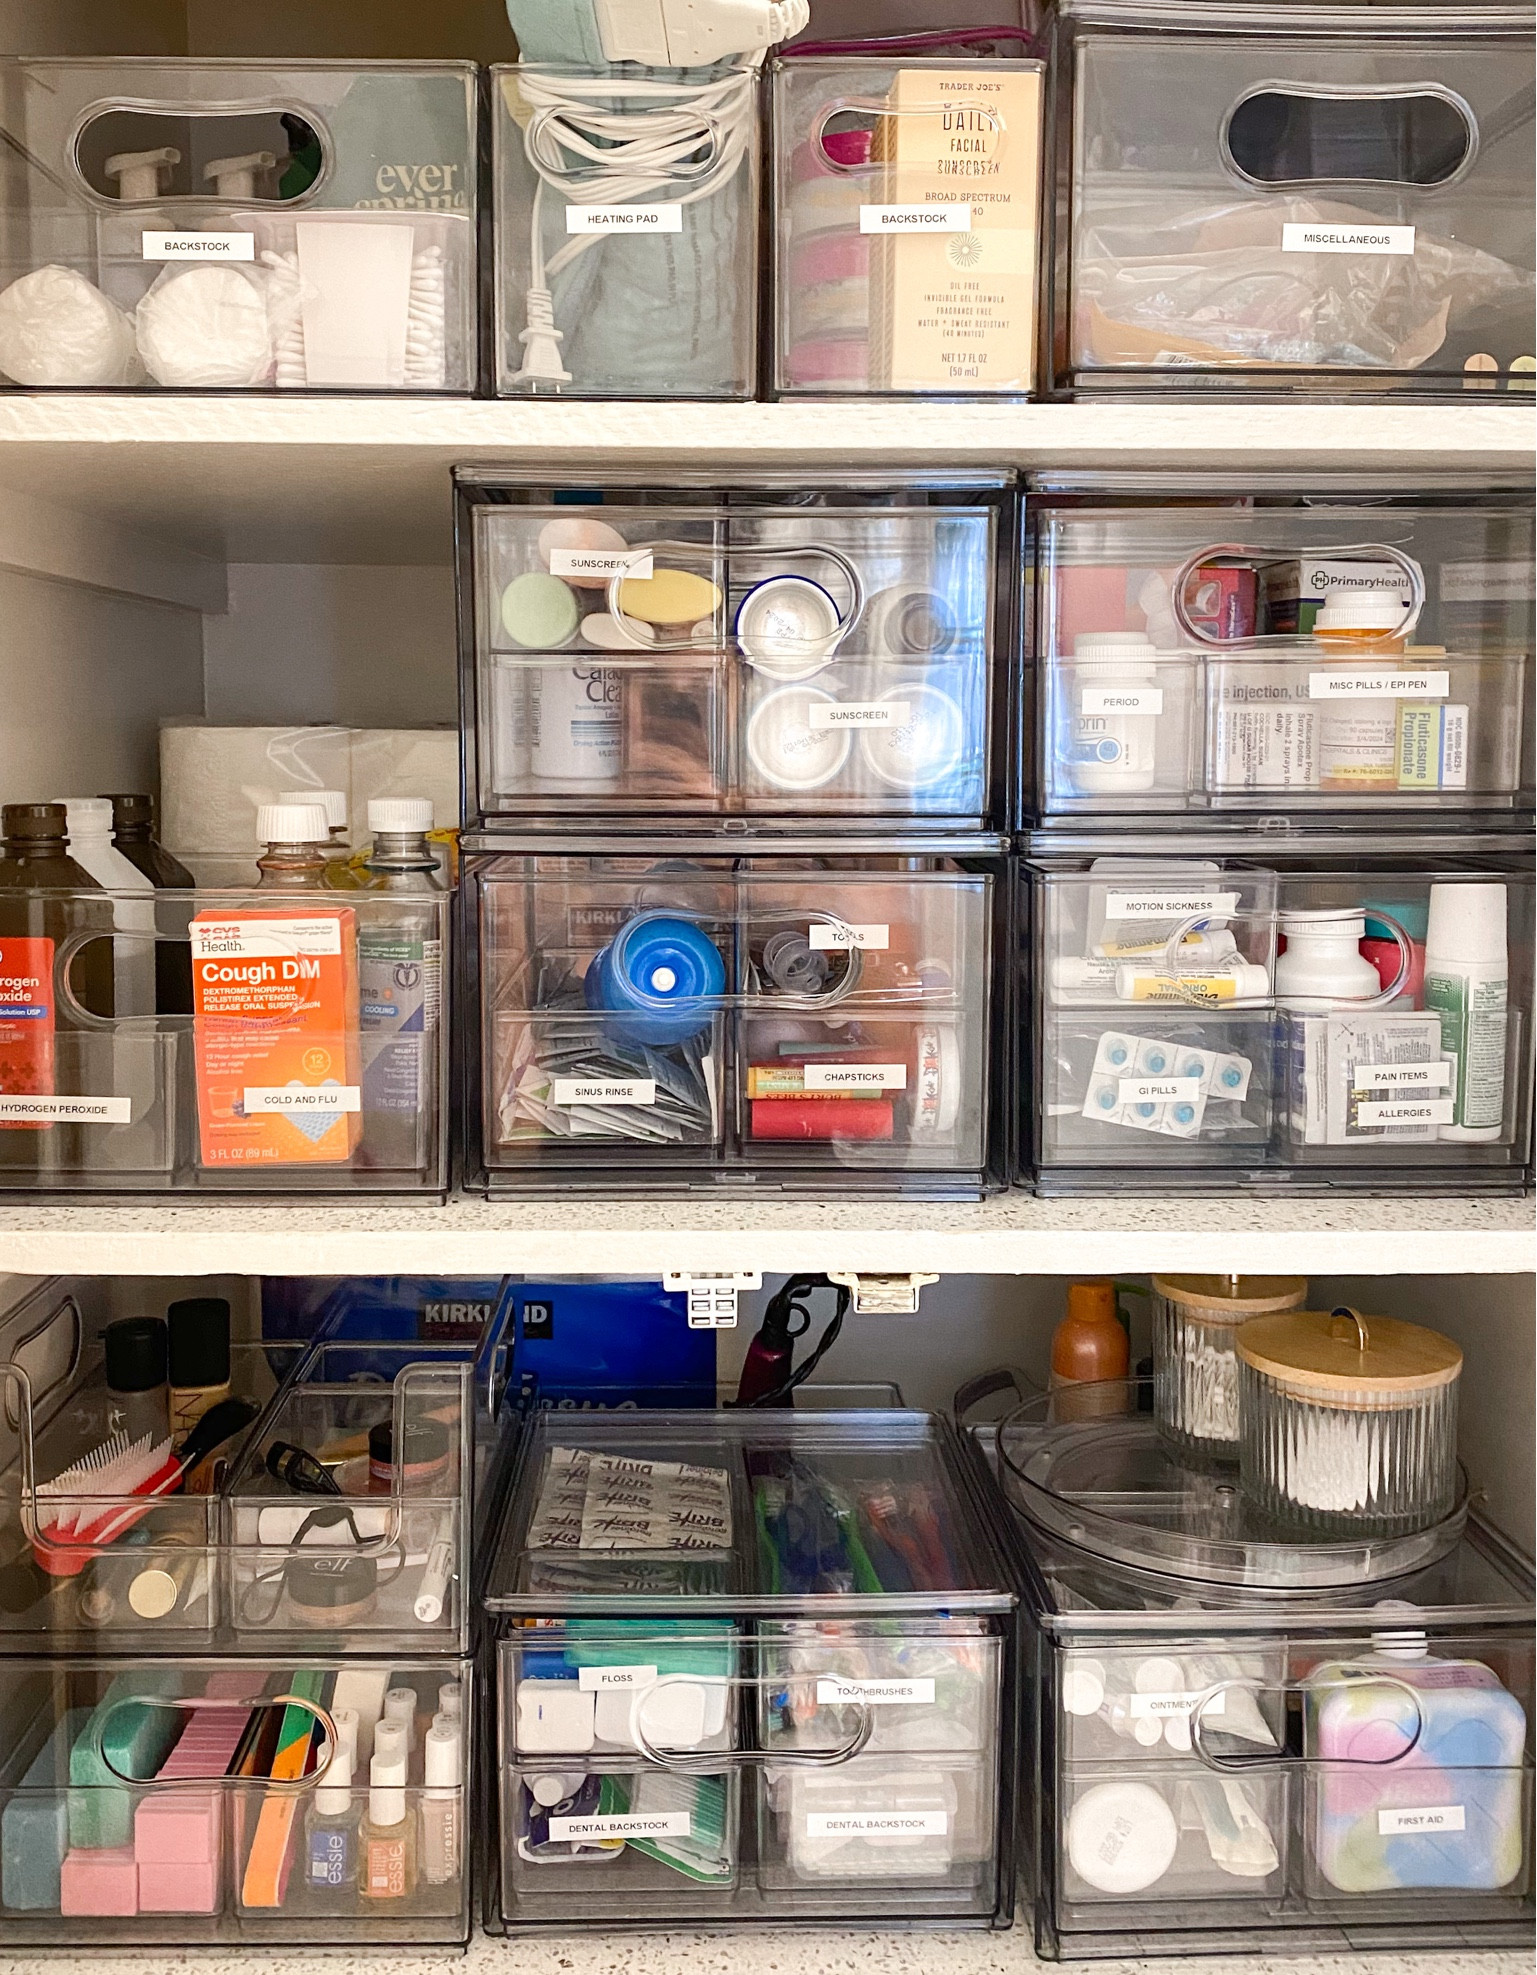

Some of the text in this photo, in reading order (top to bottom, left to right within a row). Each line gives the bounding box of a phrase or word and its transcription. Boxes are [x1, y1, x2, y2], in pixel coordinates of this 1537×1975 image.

[940, 82, 1001, 92] TRADER JOE'S
[950, 138, 987, 152] FACIAL
[376, 164, 458, 193] ever
[925, 192, 1011, 203] BROAD SPECTRUM
[972, 206, 984, 216] 40
[587, 214, 659, 224] HEATING PAD
[882, 214, 948, 224] BACKSTOCK
[1304, 234, 1391, 245] MISCELLANEOUS
[164, 242, 230, 251] BACKSTOCK
[942, 353, 988, 363] NET 1.7 FL OZ
[950, 366, 978, 377] (50 mL)
[1330, 682, 1354, 690] MISC
[1356, 681, 1382, 689] PILLS
[1390, 681, 1406, 689] EPI
[1408, 680, 1428, 688] PEN
[1233, 685, 1292, 701] injection,
[1296, 685, 1310, 698] US
[1103, 698, 1140, 706] PERIOD
[830, 711, 889, 720] SUNSCREEN
[1402, 712, 1417, 775] Propionate
[1416, 712, 1430, 779] Fluticasone
[1282, 748, 1291, 772] sprays
[1126, 902, 1213, 911] MOTION SICKNESS
[576, 910, 625, 924] KIRKL
[201, 940, 242, 952] Health
[202, 962, 276, 984] Cough
[203, 986, 296, 996] DEXTROMETHORPHAN
[204, 994, 298, 1004] POLISTIREX EXTENDED
[204, 1003, 241, 1012] RELEASE
[243, 1002, 266, 1010] ORAL
[364, 1006, 394, 1014] COOLING
[310, 1054, 324, 1064] 12
[824, 1073, 885, 1082] CHAPSTICKS
[1374, 1072, 1428, 1081] PAIN ITEMS
[575, 1088, 634, 1096] SINUS RINSE
[1138, 1086, 1178, 1095] GI PILLS
[264, 1096, 338, 1104] COLD AND FLU
[1, 1104, 108, 1114] HYDROGEN PEROXIDE
[1378, 1108, 1432, 1118] ALLERGIES
[210, 1148, 279, 1160] 3 FL OZ (89 mL)
[601, 1674, 634, 1682] FLOSS
[826, 1820, 926, 1829] DENTAL BACKSTOCK
[1398, 1816, 1444, 1825] FIRST AID
[569, 1821, 669, 1833] DENTAL BACKSTOCK
[328, 1835, 343, 1884] essie
